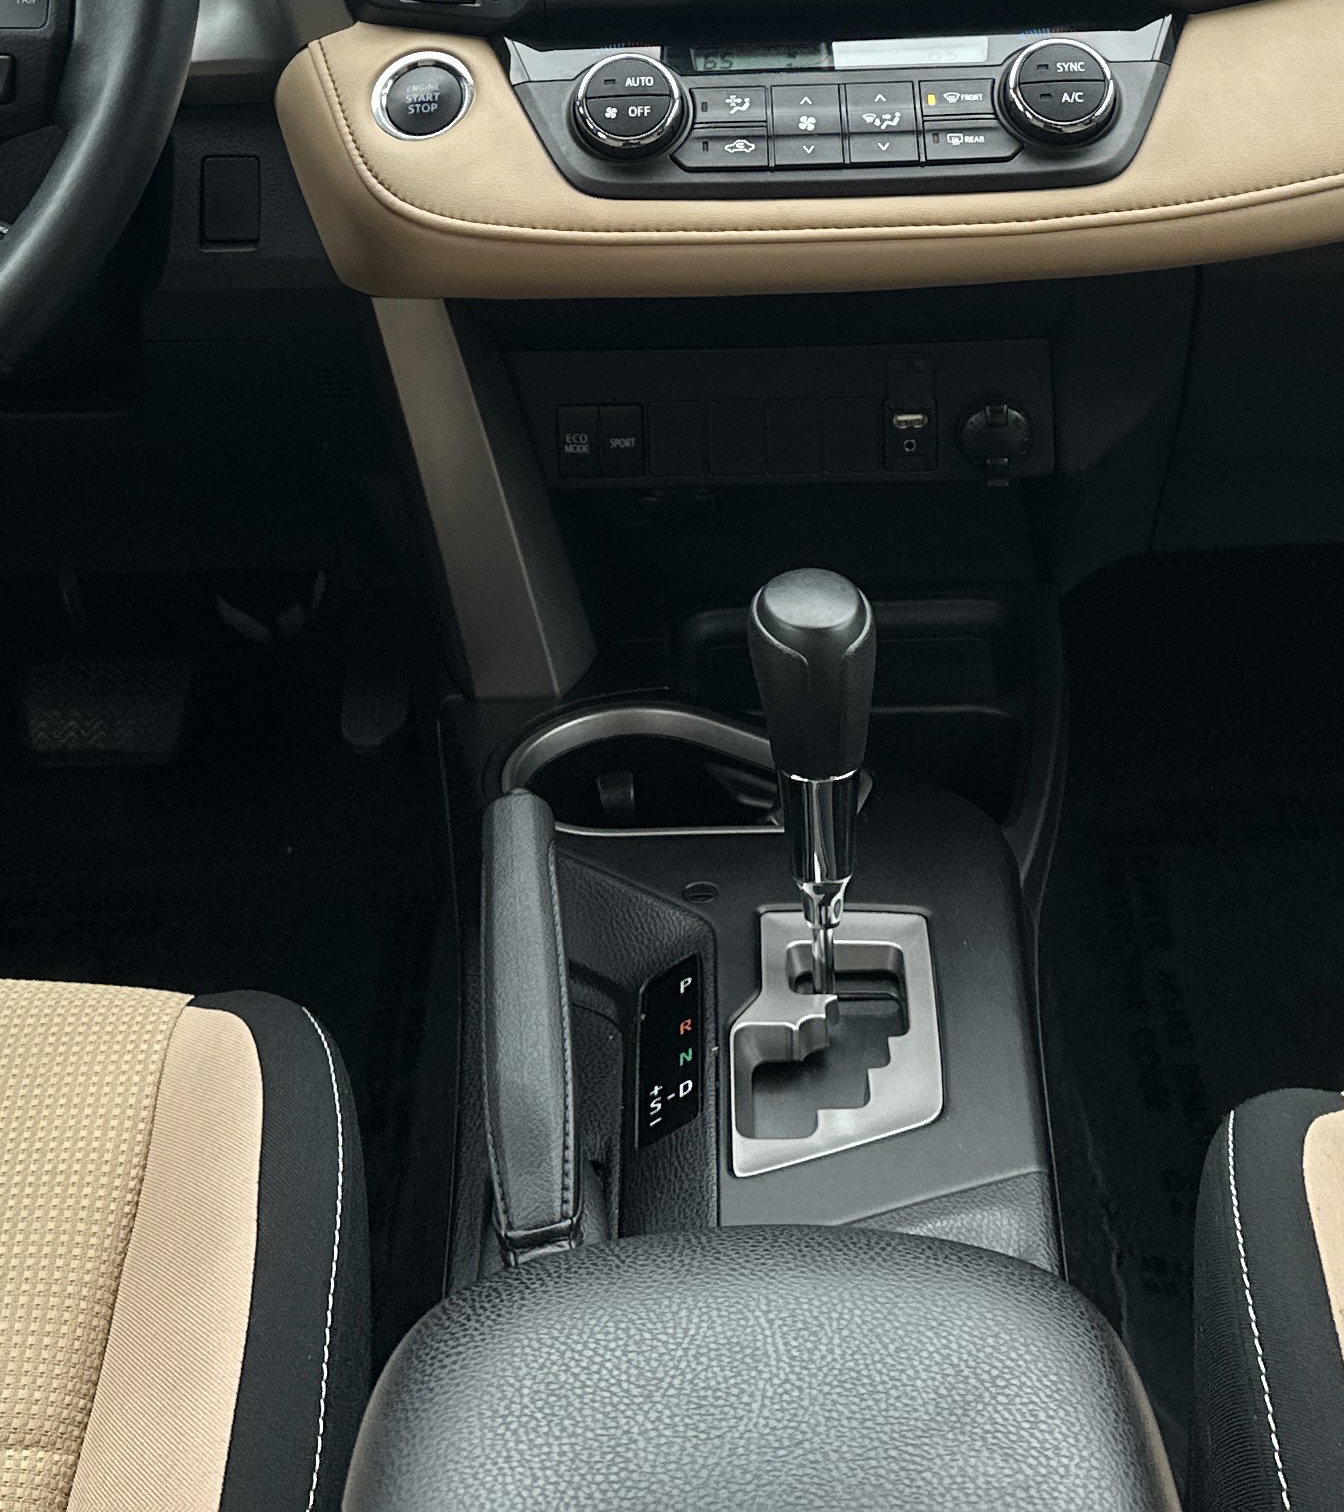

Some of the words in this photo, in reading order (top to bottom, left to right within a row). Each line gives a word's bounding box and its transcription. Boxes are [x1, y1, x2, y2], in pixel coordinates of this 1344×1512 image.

[1056, 61, 1086, 73] SYNC
[624, 75, 654, 88] AUTO
[406, 83, 440, 93] ENGINE
[406, 92, 441, 104] START
[960, 92, 983, 102] FRONT
[1060, 91, 1084, 104] A/C
[408, 102, 439, 115] STOP
[628, 105, 652, 118] OFF
[964, 134, 985, 144] REAR
[565, 432, 589, 443] ECO
[608, 437, 637, 449] SPORT
[564, 443, 591, 453] MODE
[679, 976, 693, 994] P
[679, 1018, 693, 1035] R
[679, 1047, 693, 1066] N
[679, 1079, 693, 1098] D
